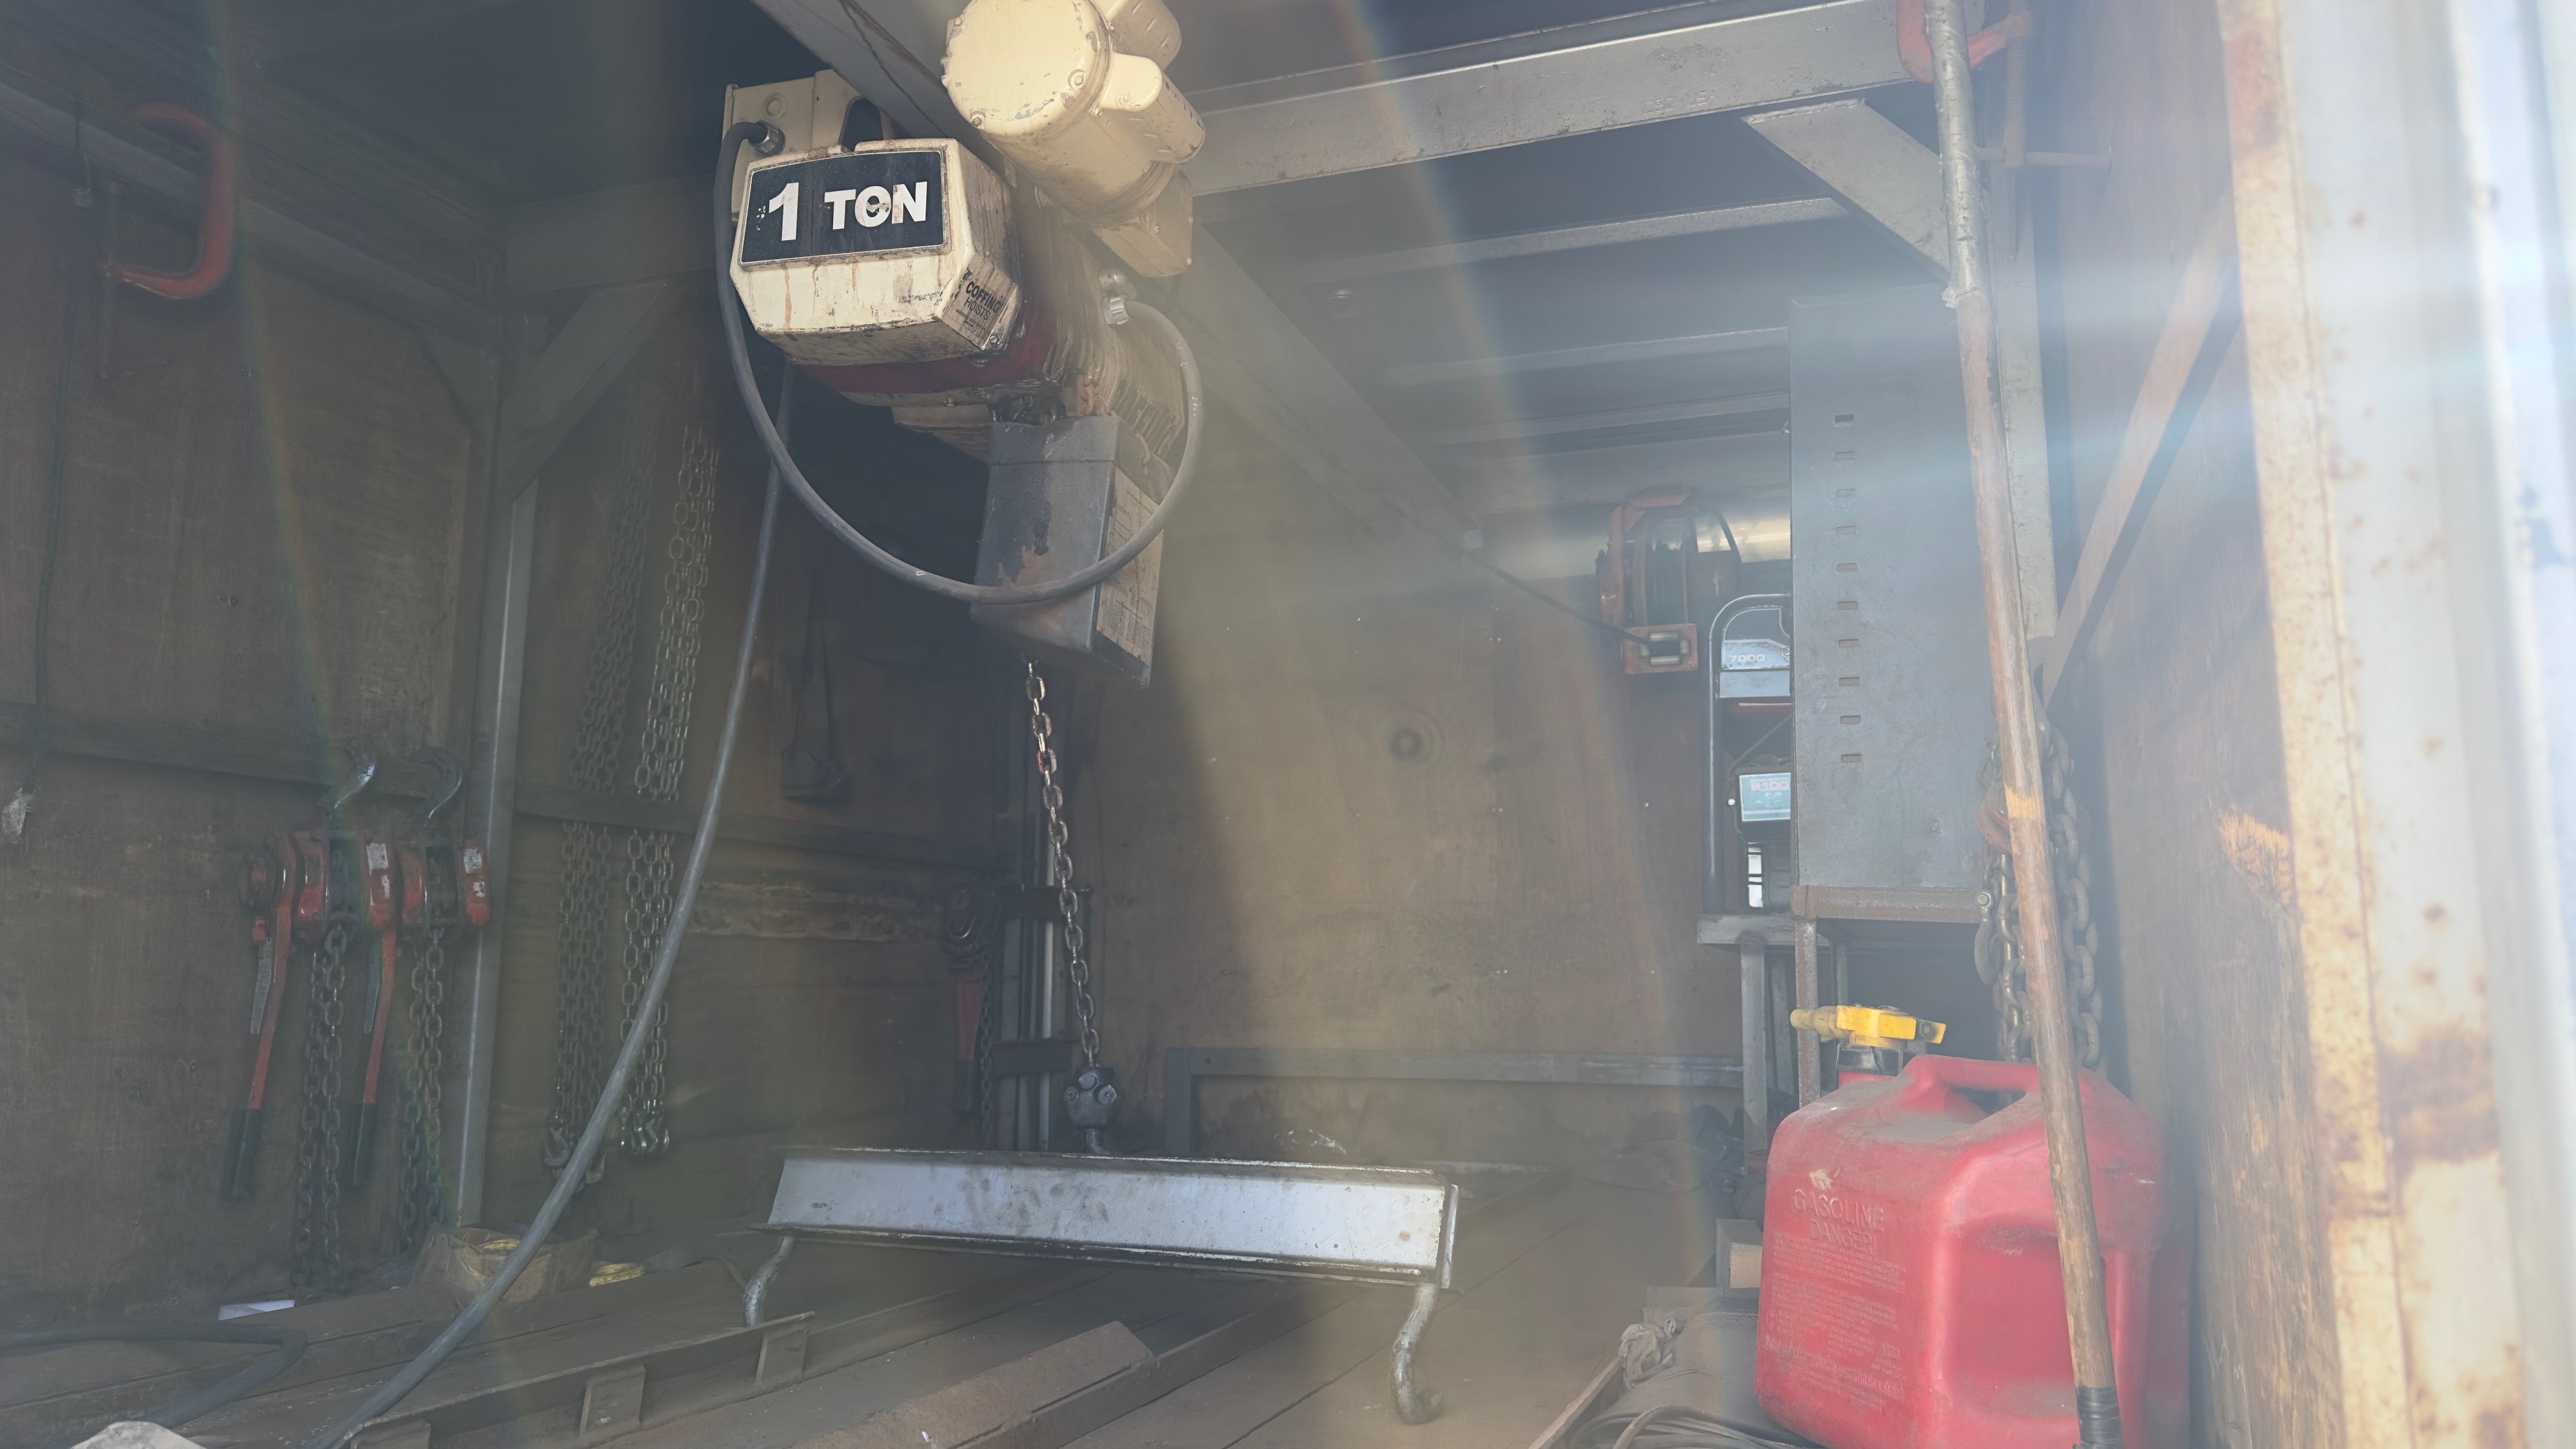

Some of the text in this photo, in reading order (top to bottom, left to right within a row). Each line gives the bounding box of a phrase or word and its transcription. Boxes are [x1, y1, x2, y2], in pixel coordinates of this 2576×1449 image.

[769, 181, 928, 241] 1 TON
[963, 296, 991, 320] HOISTS
[965, 281, 1004, 314] COFFING
[1729, 654, 1765, 663] 7000
[1793, 1188, 1884, 1232] GASOLINE
